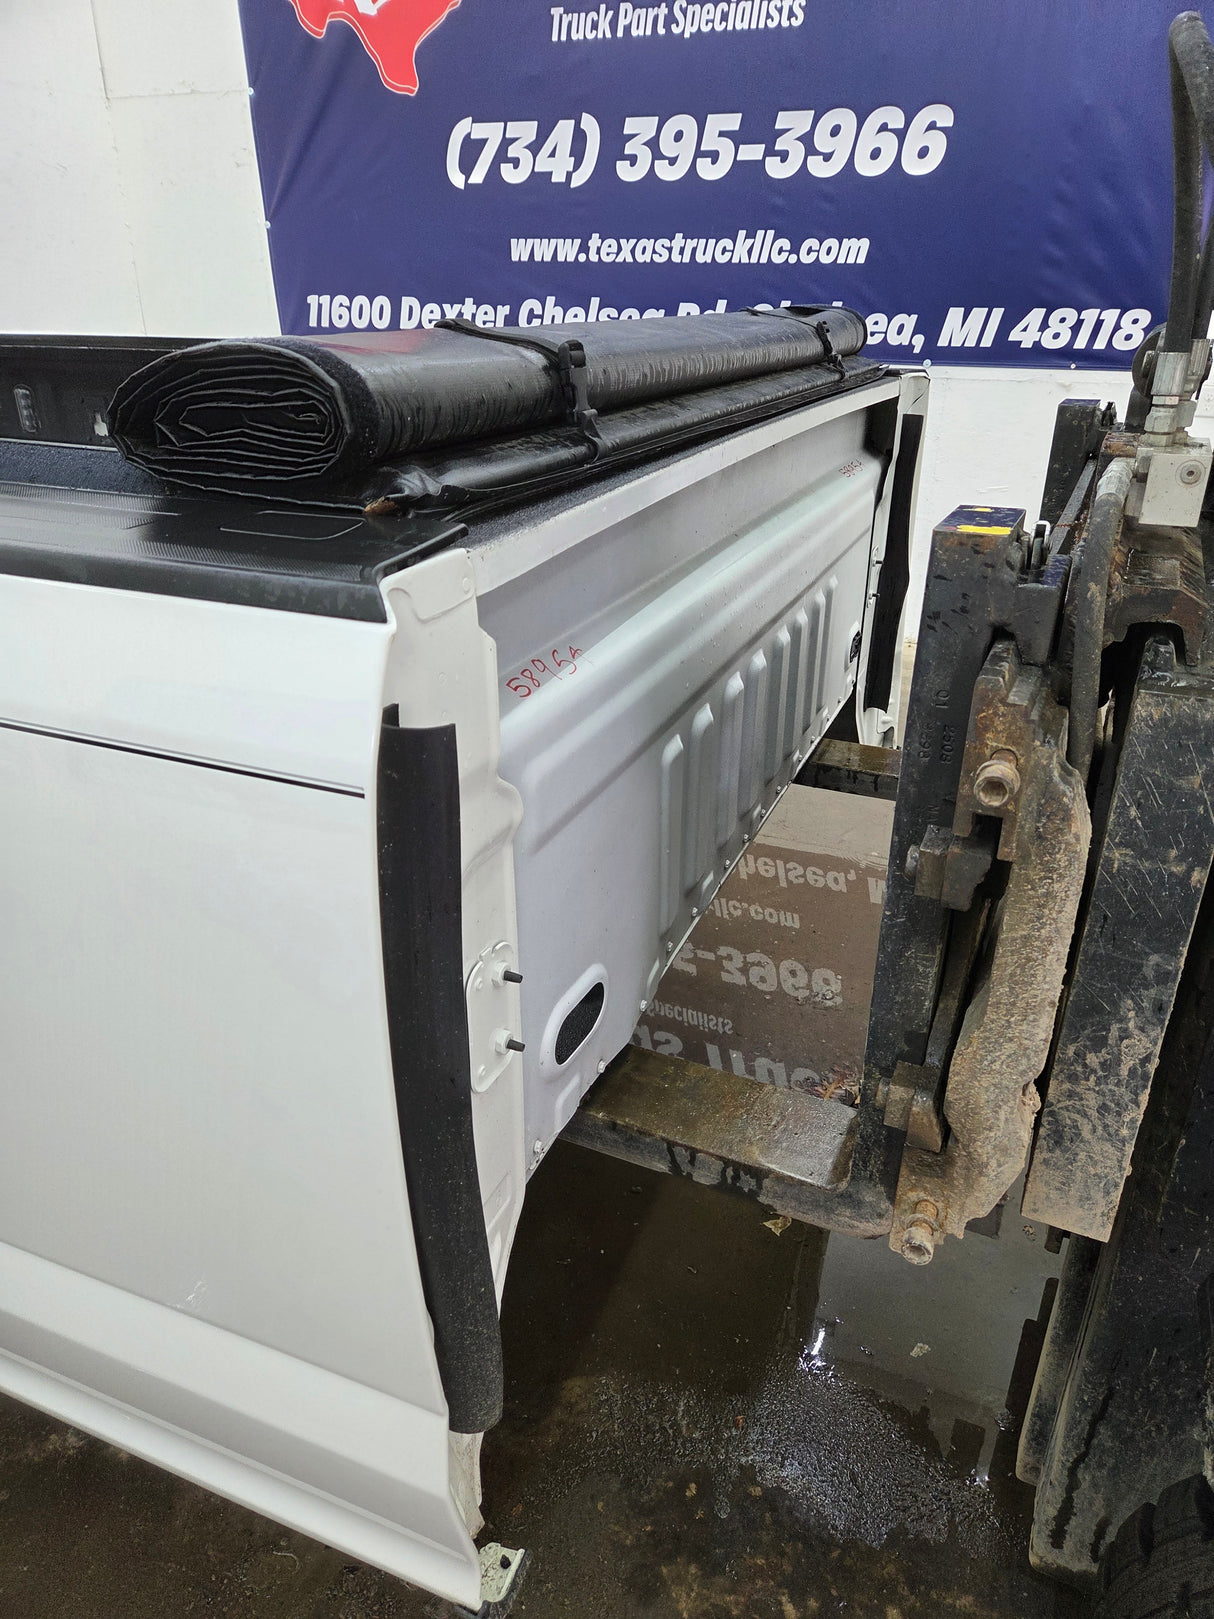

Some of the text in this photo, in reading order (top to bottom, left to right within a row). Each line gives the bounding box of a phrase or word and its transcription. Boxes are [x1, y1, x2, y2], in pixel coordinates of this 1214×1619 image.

[550, 0, 806, 42] Truck Part Specialists
[447, 104, 955, 190] (734) 395-3966
[510, 229, 870, 264] www.texastruckllc.com
[307, 294, 392, 329] 11600
[400, 297, 510, 330] Dexter
[937, 307, 1003, 348] MI
[1008, 307, 1152, 351] 48118
